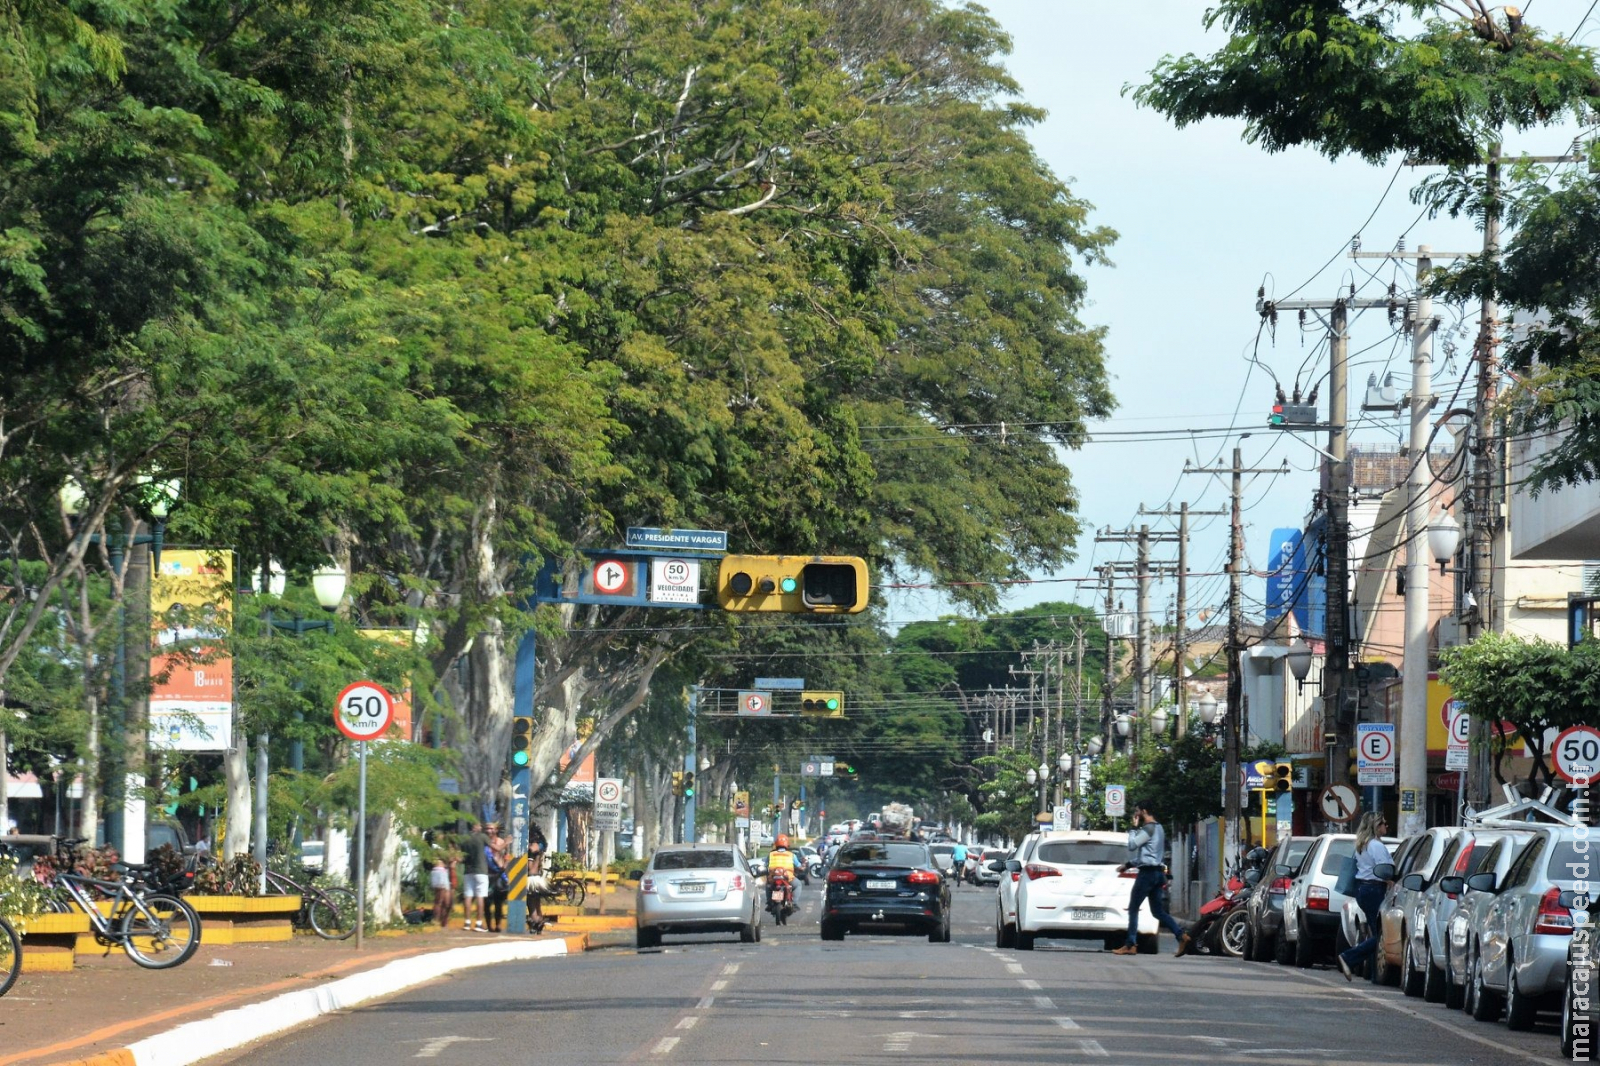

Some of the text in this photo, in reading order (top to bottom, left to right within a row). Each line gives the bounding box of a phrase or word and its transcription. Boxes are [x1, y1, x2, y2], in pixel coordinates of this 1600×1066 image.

[631, 533, 722, 544] AV. PRESIDENTE VARGAS
[668, 564, 684, 574] 50
[194, 670, 205, 687] 18
[346, 696, 382, 718] 50
[352, 719, 378, 728] km/h
[1371, 739, 1381, 754] E
[1563, 739, 1599, 762] 50
